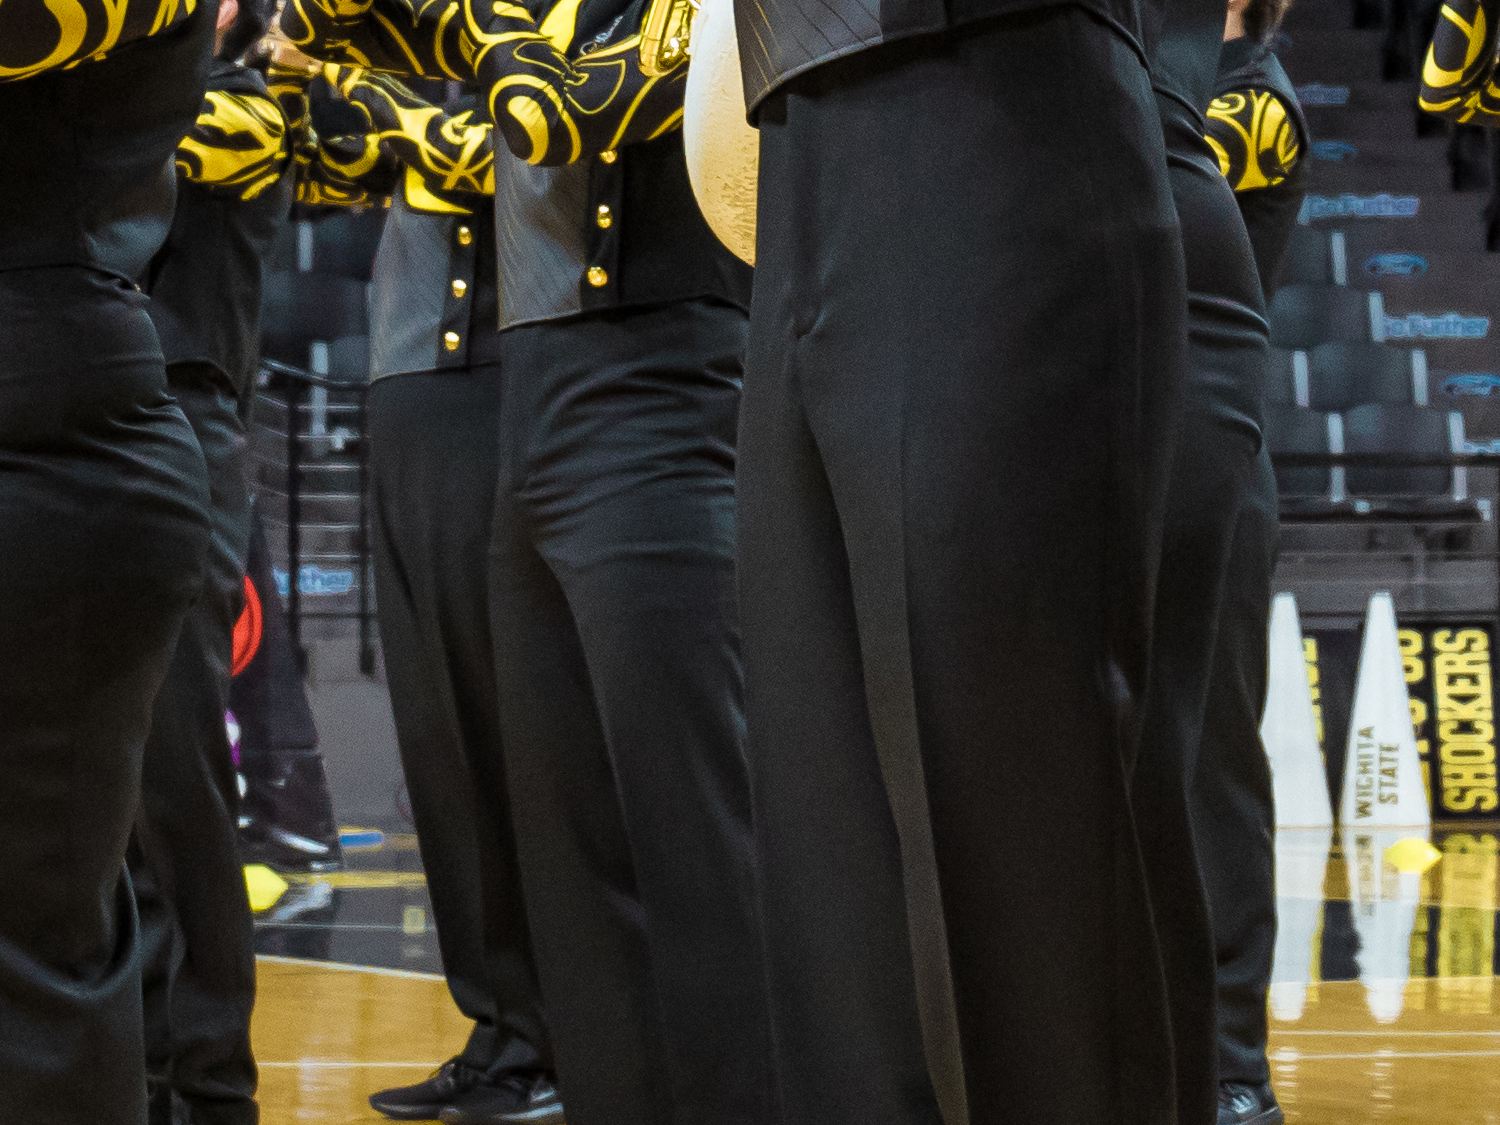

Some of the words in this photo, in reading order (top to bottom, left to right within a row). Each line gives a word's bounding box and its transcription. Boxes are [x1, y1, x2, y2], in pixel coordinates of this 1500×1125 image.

[1432, 628, 1498, 812] SHOCKERS
[1354, 725, 1376, 820] WICHITA
[1378, 742, 1400, 806] STATE
